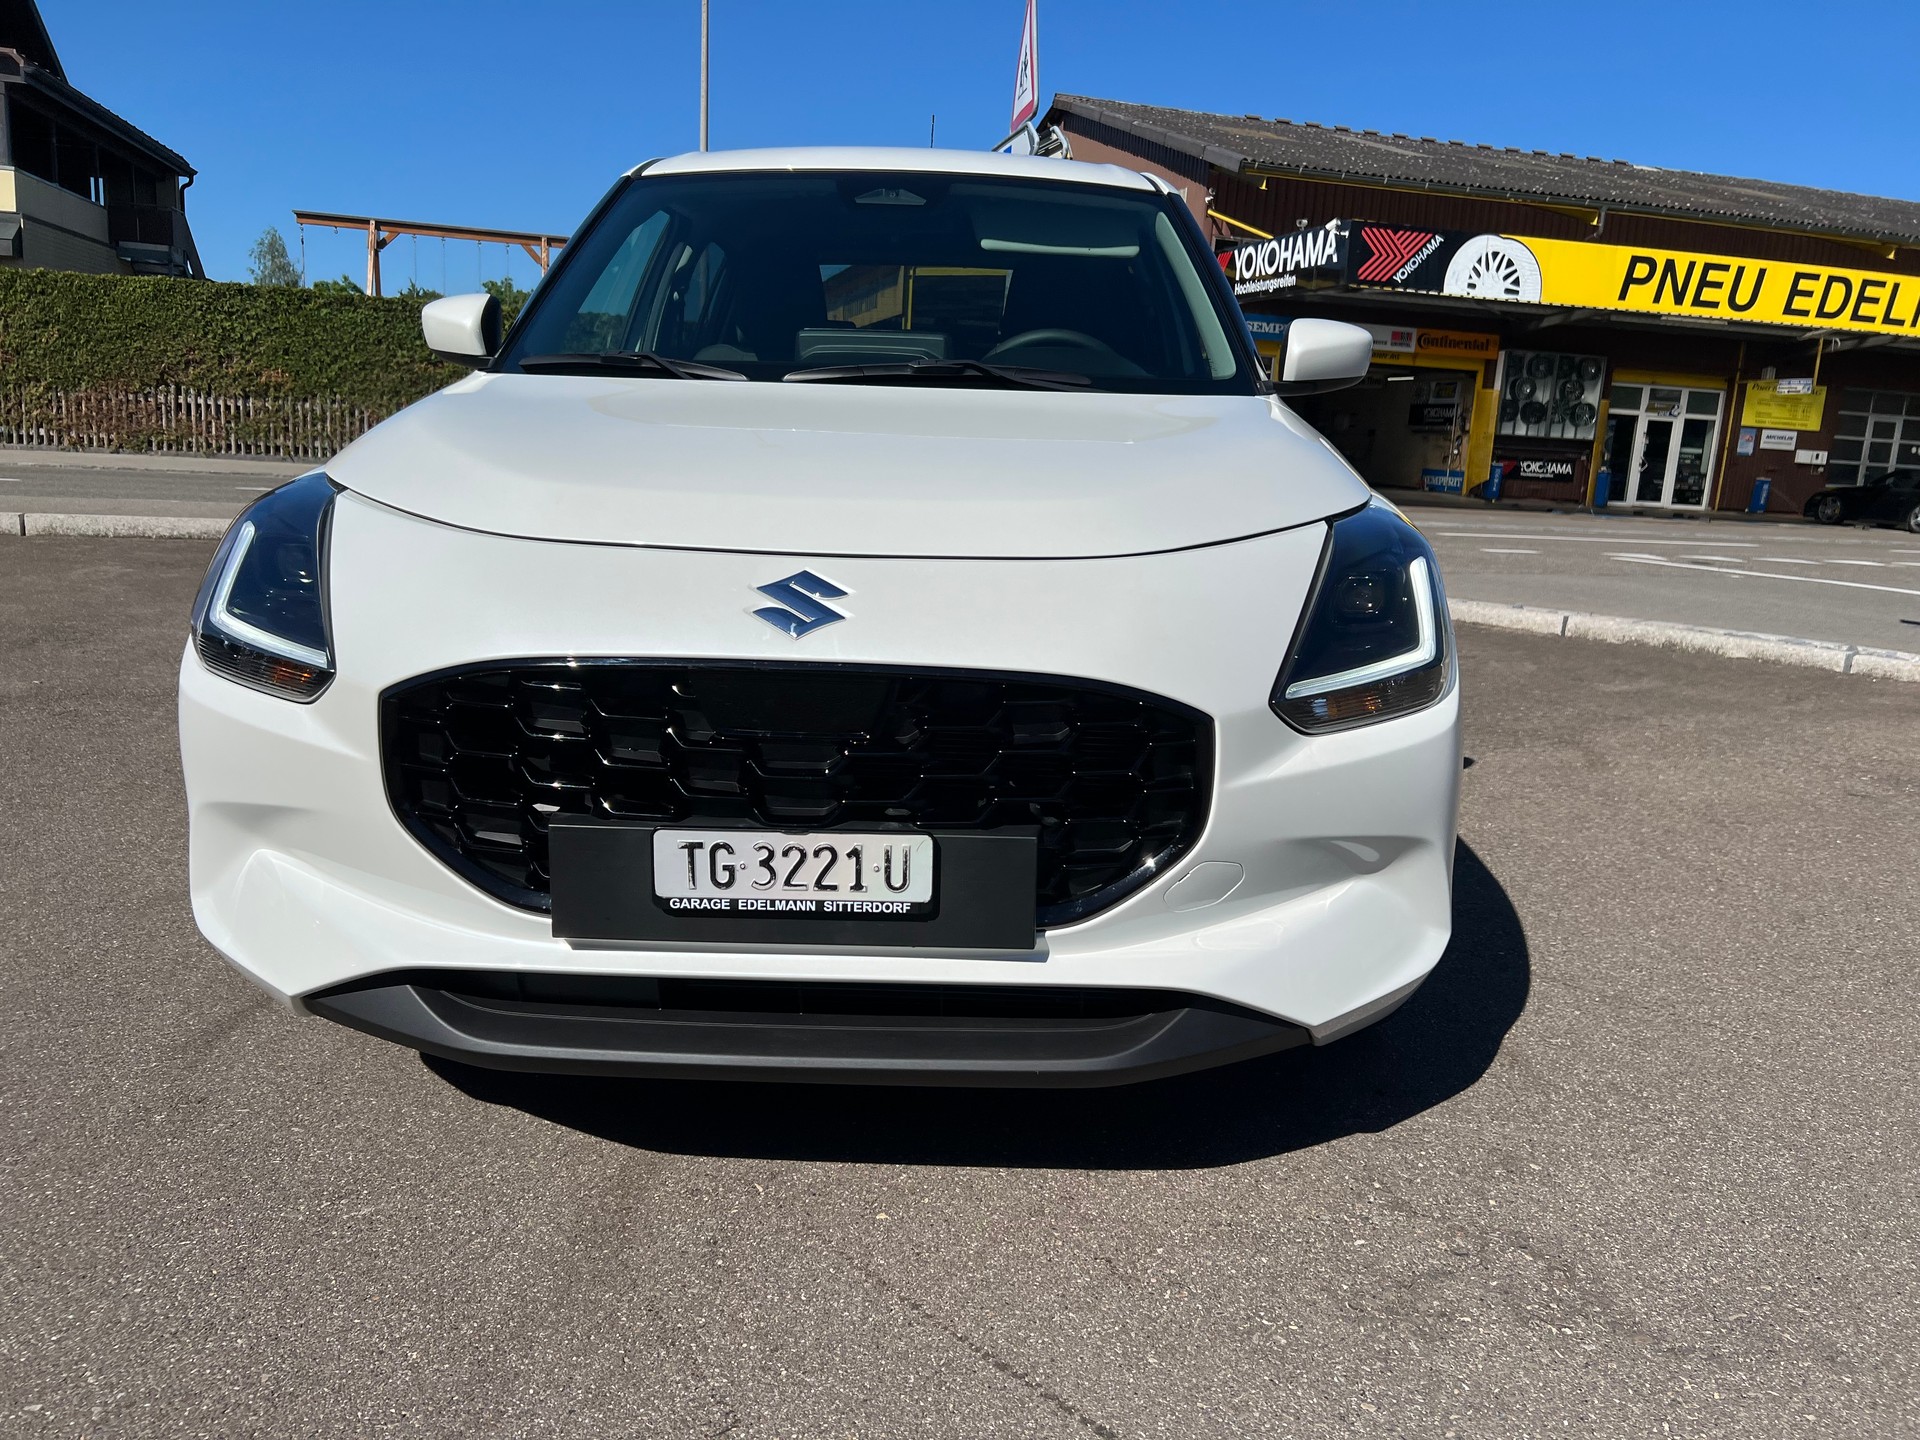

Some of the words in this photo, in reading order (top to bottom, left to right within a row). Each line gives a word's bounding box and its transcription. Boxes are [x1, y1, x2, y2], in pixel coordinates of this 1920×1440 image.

[1234, 229, 1338, 281] YOKOHAMA
[1393, 234, 1444, 284] YOKOHAMA
[1234, 274, 1297, 296] Hochleistungsreifen
[1617, 254, 1768, 313] PNEU
[1246, 320, 1284, 334] SEMP
[1417, 332, 1490, 352] Continental
[669, 897, 731, 911] GARAGE
[737, 898, 817, 912] EDELMANN
[823, 899, 912, 914] SITTERDORF
